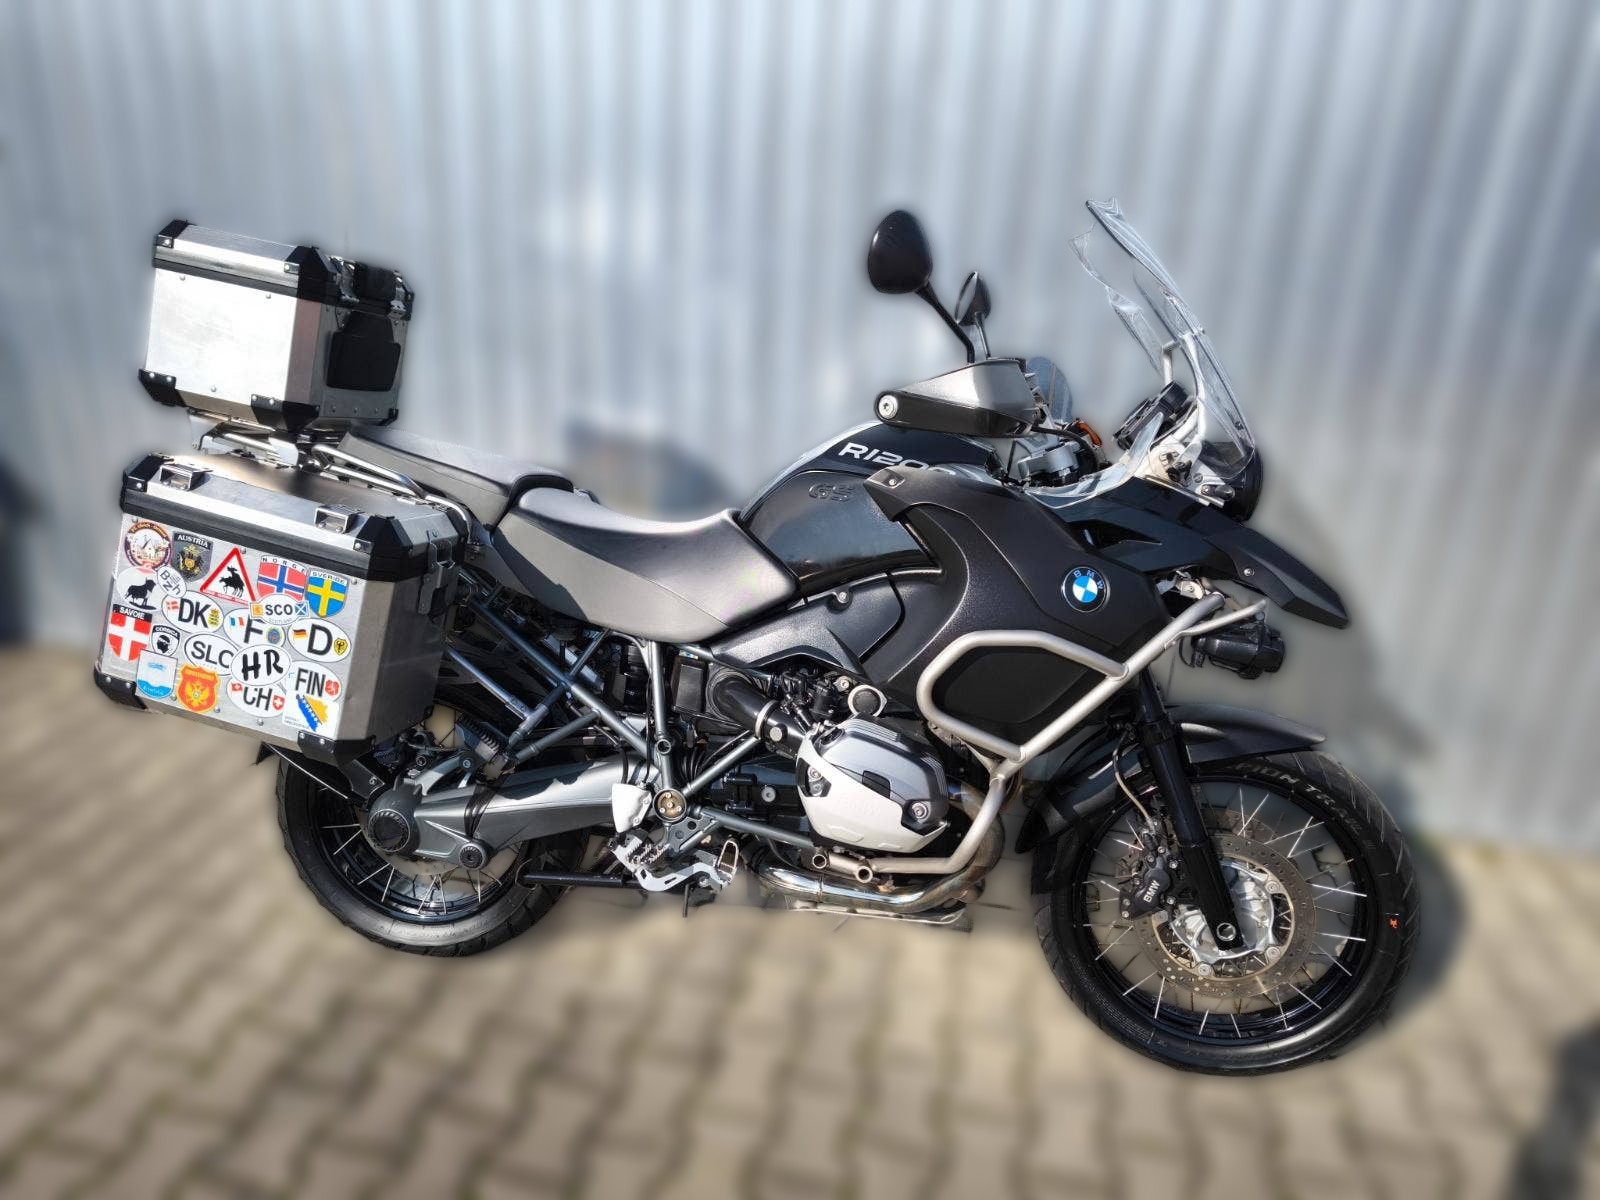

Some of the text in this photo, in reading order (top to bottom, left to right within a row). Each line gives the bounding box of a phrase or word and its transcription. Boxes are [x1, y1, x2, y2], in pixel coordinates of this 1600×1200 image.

[177, 534, 209, 548] AUSTRIA
[1073, 570, 1104, 589] BMW
[119, 606, 145, 620] SAVOIE
[178, 598, 212, 629] DK
[265, 604, 293, 616] SCO
[243, 614, 264, 644] F
[307, 623, 333, 656] D
[241, 649, 284, 681] HR
[295, 667, 326, 697] FIN
[243, 686, 272, 711] CH
[1143, 880, 1161, 903] BMW
